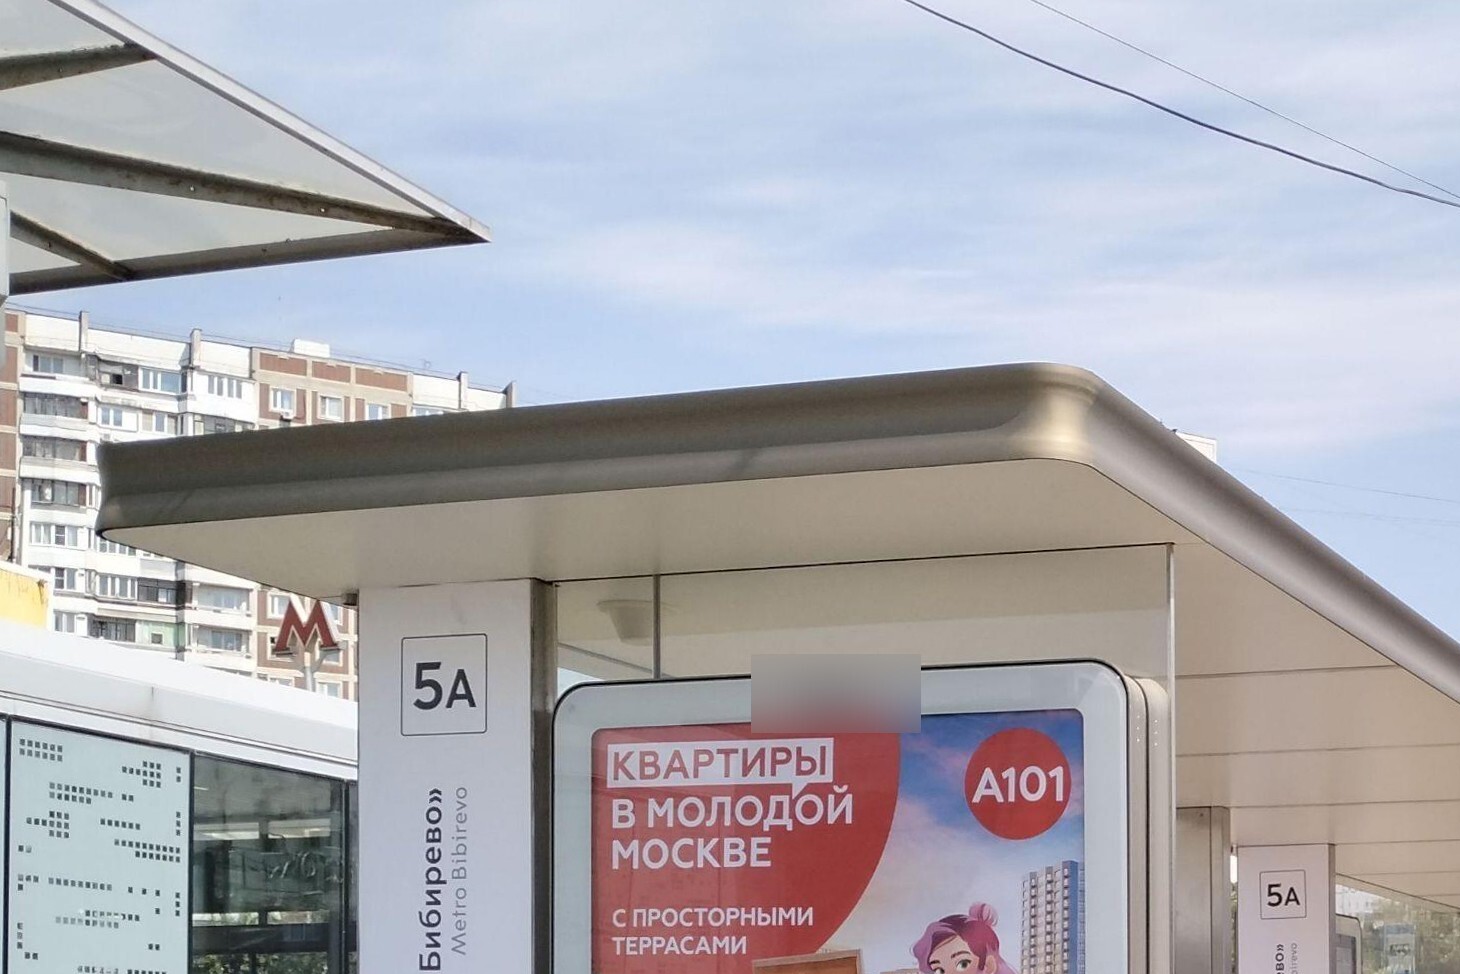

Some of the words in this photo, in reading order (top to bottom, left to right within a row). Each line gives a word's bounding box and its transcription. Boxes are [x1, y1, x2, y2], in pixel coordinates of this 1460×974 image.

[413, 661, 477, 711] 5А
[612, 744, 828, 781] КВАРТИРЫ
[971, 765, 1065, 804] А101
[611, 799, 633, 829] В
[648, 785, 853, 831] МОЛОДОЙ
[451, 786, 468, 880] Bibirevo
[611, 837, 772, 870] МОСКВЕ
[1267, 883, 1301, 907] 5А
[451, 887, 468, 956] Metro
[612, 909, 626, 928] С
[632, 906, 814, 929] ПРОСТОРНЫМИ
[611, 936, 747, 957] ТЕРРАСАМИ
